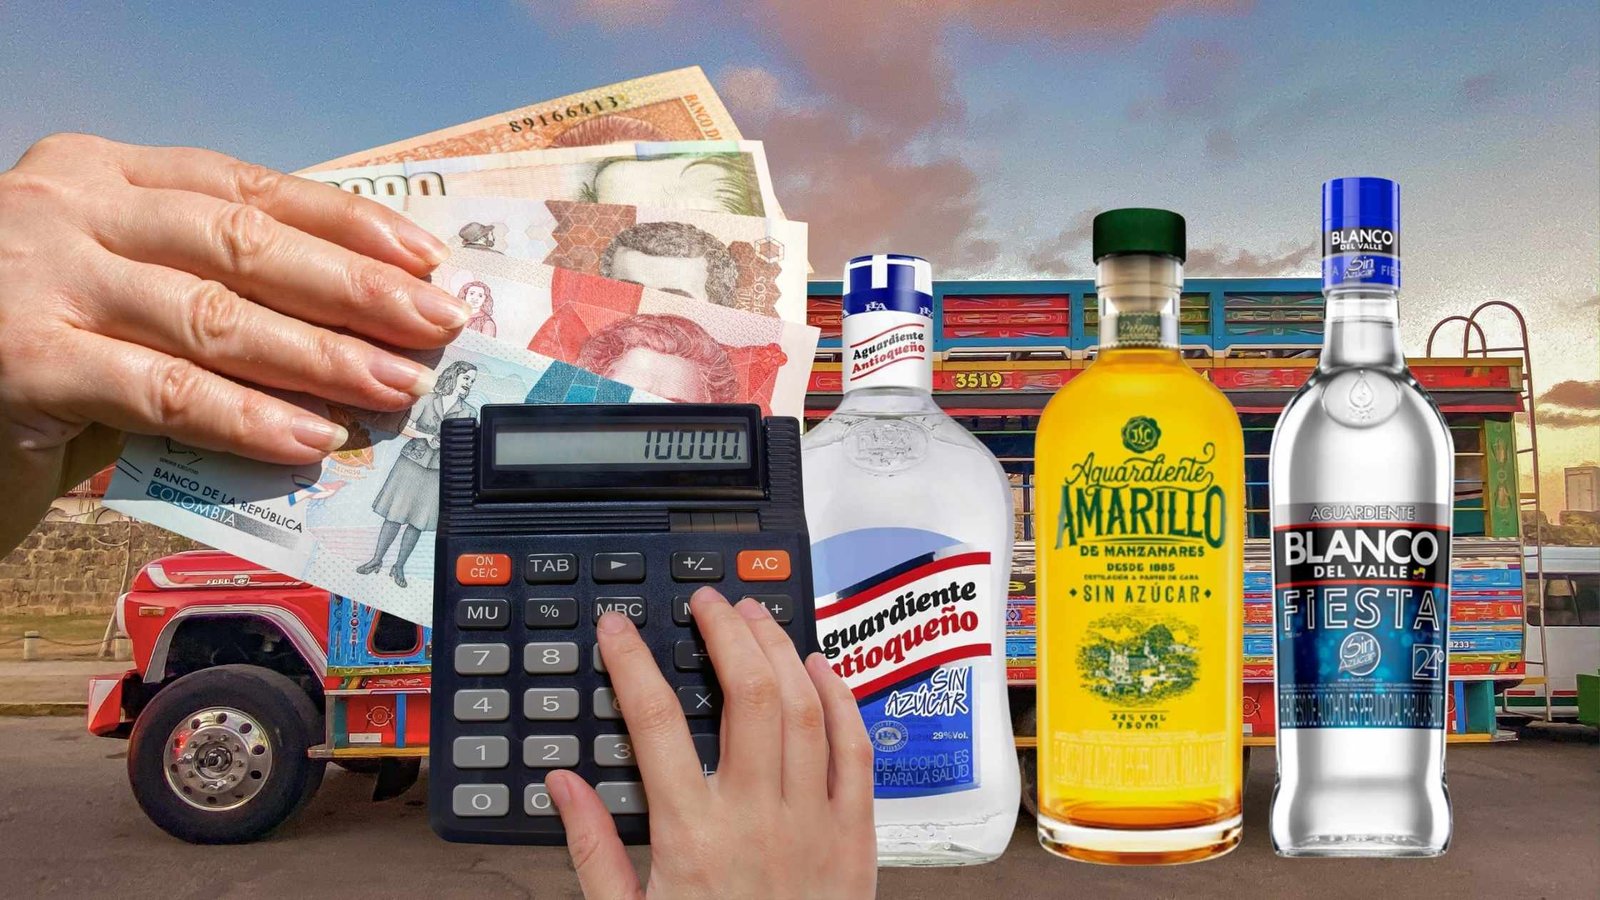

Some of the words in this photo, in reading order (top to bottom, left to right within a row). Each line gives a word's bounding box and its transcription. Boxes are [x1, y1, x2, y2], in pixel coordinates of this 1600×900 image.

[509, 96, 618, 132] 89166413
[1331, 229, 1393, 245] BLANCO
[1358, 243, 1382, 251] VALLE
[754, 276, 767, 315] PESOS
[853, 332, 924, 360] Aguardiente
[852, 342, 925, 374] Antioqueño
[956, 372, 1002, 388] 3519
[1065, 442, 1214, 497] Aguardiente
[149, 484, 236, 527] COLOMBIA
[153, 467, 200, 492] BANCO
[202, 486, 220, 500] DE
[221, 493, 236, 507] LA
[239, 500, 303, 534] REPÚBLICA
[1055, 485, 1226, 549] AMARILLO
[1310, 505, 1416, 521] AGUARDIENTE
[1080, 545, 1099, 557] DE
[1104, 545, 1205, 557] MANZANARES
[1285, 529, 1439, 566] BLANCO
[476, 555, 494, 566] ON
[530, 559, 570, 573] TAB
[752, 557, 778, 570] AC
[1107, 563, 1144, 571] DESDE
[470, 568, 498, 578] CE/C
[1314, 565, 1346, 578] DEL
[1352, 565, 1408, 578] VALLE
[1083, 584, 1115, 603] SIN
[1124, 582, 1200, 603] AZÚCAR
[467, 606, 499, 619] MU
[540, 604, 560, 618] %
[1283, 587, 1440, 631] FIESTA
[821, 581, 977, 660] guardiente
[831, 605, 979, 678] ntioqueño
[473, 650, 490, 666] 7
[542, 648, 560, 665] 8
[932, 668, 967, 692] SIN
[473, 697, 492, 713] 4
[542, 696, 560, 712] 5
[886, 685, 968, 717] AZÚCAR
[475, 744, 486, 761] 1
[542, 744, 560, 760] 2
[613, 742, 631, 759] 3
[876, 758, 893, 772] DE
[894, 753, 952, 772] ALCOHOL
[954, 749, 969, 765] ES
[883, 772, 914, 786] PARA
[916, 771, 930, 784] LA
[932, 764, 969, 783] SALUD
[472, 793, 491, 810] 0
